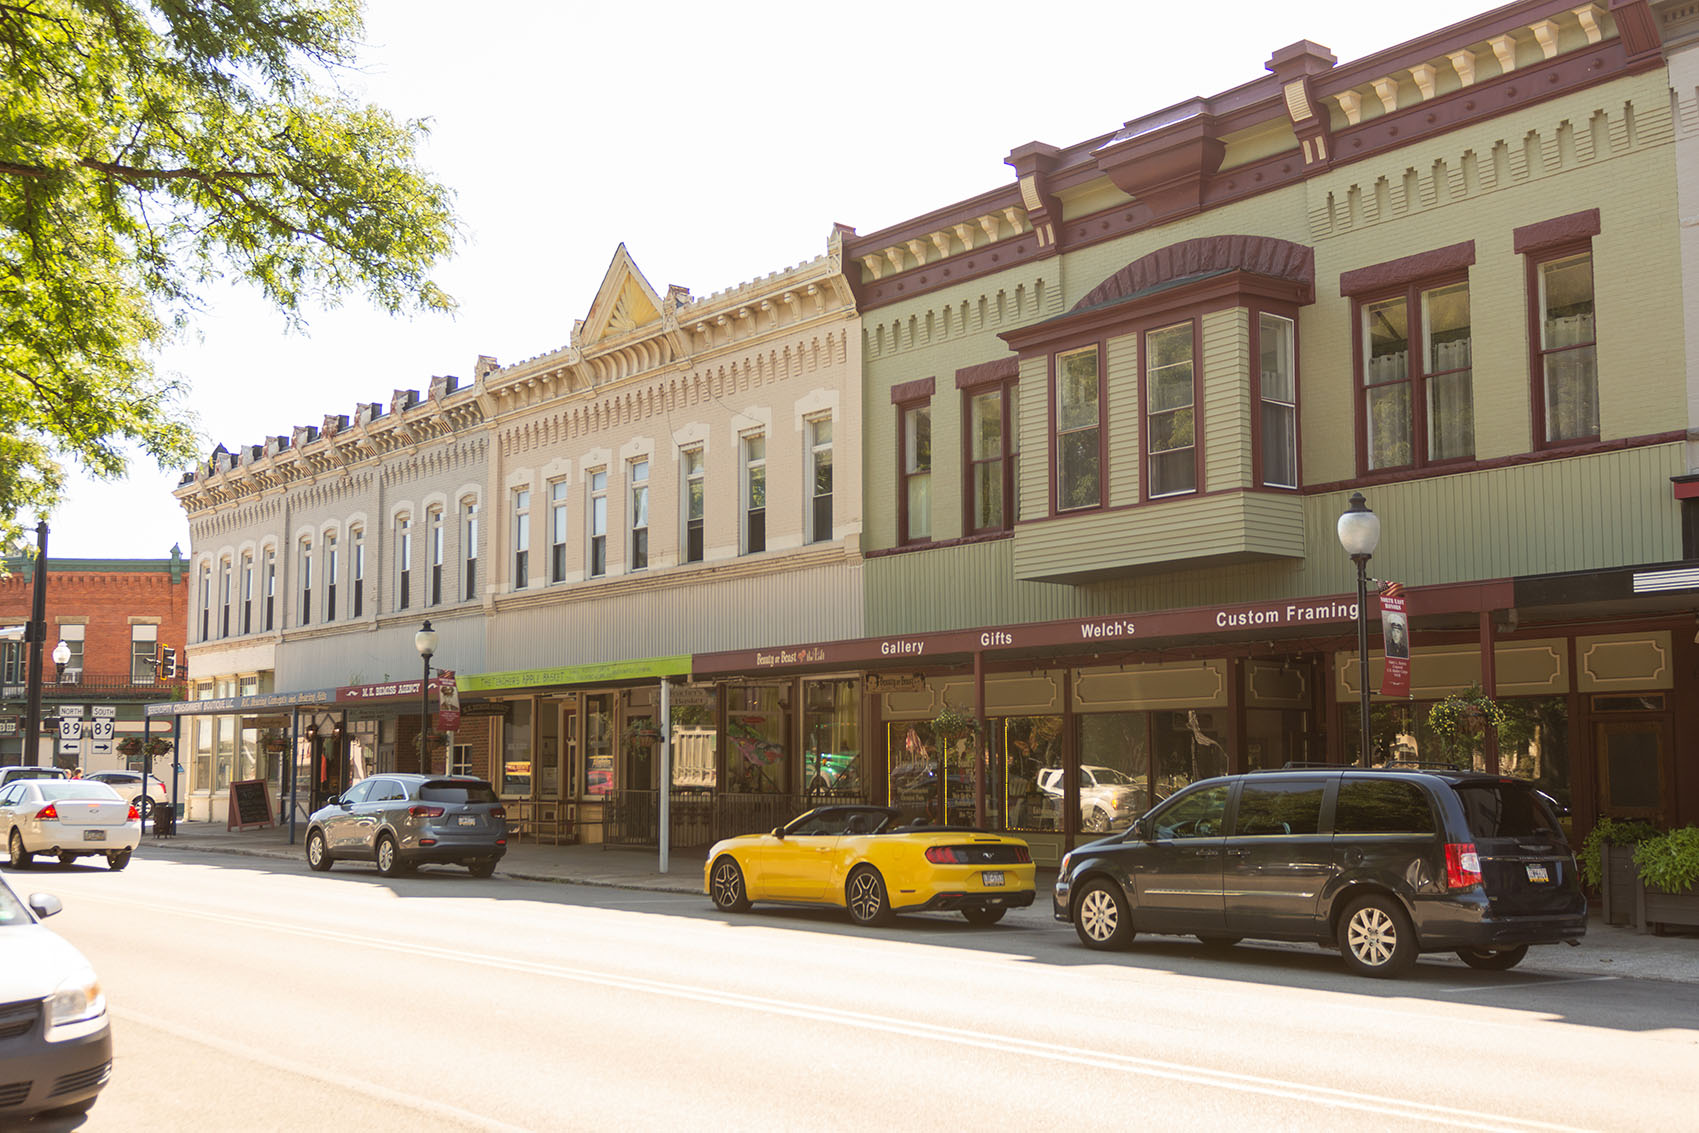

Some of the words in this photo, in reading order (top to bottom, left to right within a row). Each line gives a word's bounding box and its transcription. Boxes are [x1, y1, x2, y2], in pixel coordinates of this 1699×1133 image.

[1216, 608, 1279, 628] Custom
[1286, 602, 1359, 621] Framing
[1081, 621, 1135, 638] Welch's
[980, 631, 1013, 646] Gifts
[881, 640, 924, 655] Gallery
[756, 652, 775, 668] Beauty
[775, 656, 780, 664] or
[781, 650, 797, 663] Beast
[543, 671, 565, 683] BASKET
[375, 685, 397, 696] BEMISS
[398, 683, 420, 694] AGENCY
[94, 707, 114, 715] SOUTH
[63, 722, 80, 735] 89
[94, 722, 112, 735] 89
